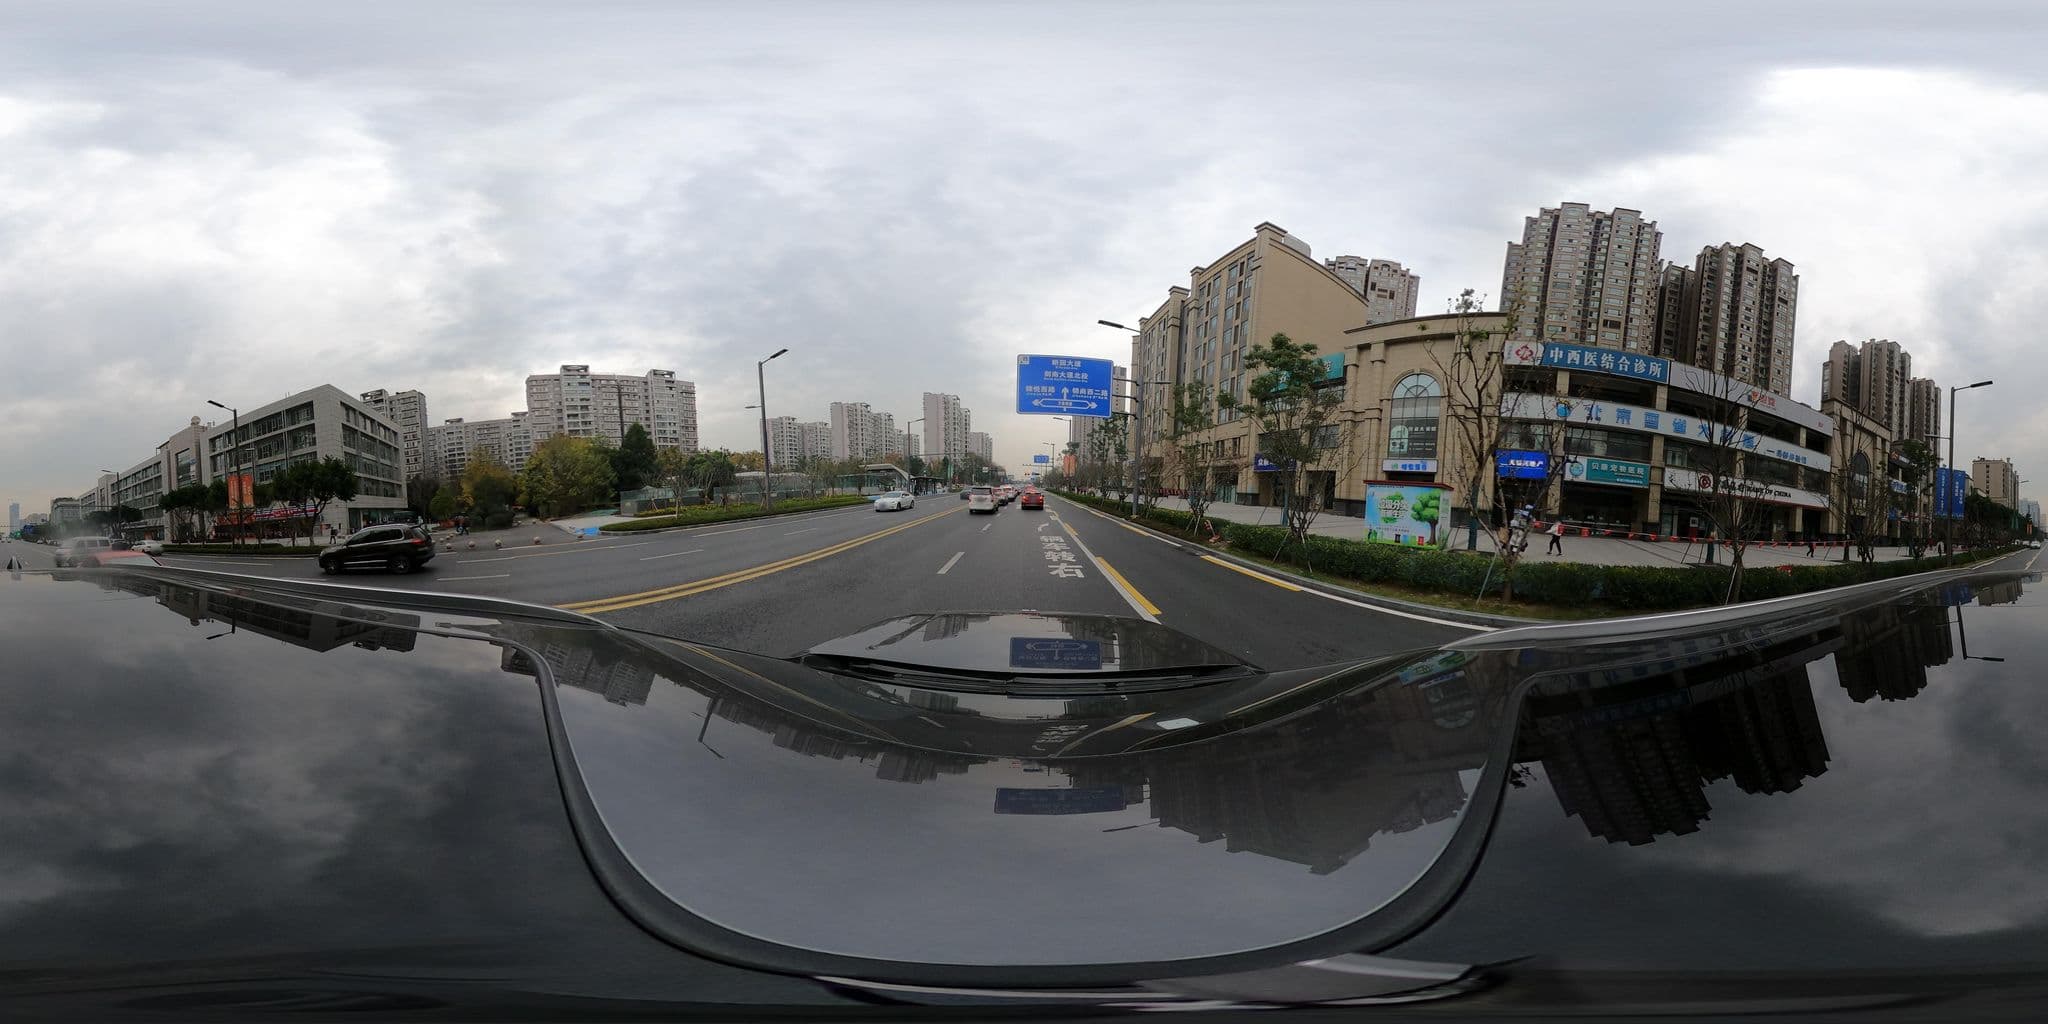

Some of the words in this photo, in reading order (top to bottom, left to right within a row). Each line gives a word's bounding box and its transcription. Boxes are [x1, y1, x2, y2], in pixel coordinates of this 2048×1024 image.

[1549, 347, 1663, 379] 中西医结合诊所
[1774, 490, 1792, 498] CHINA
